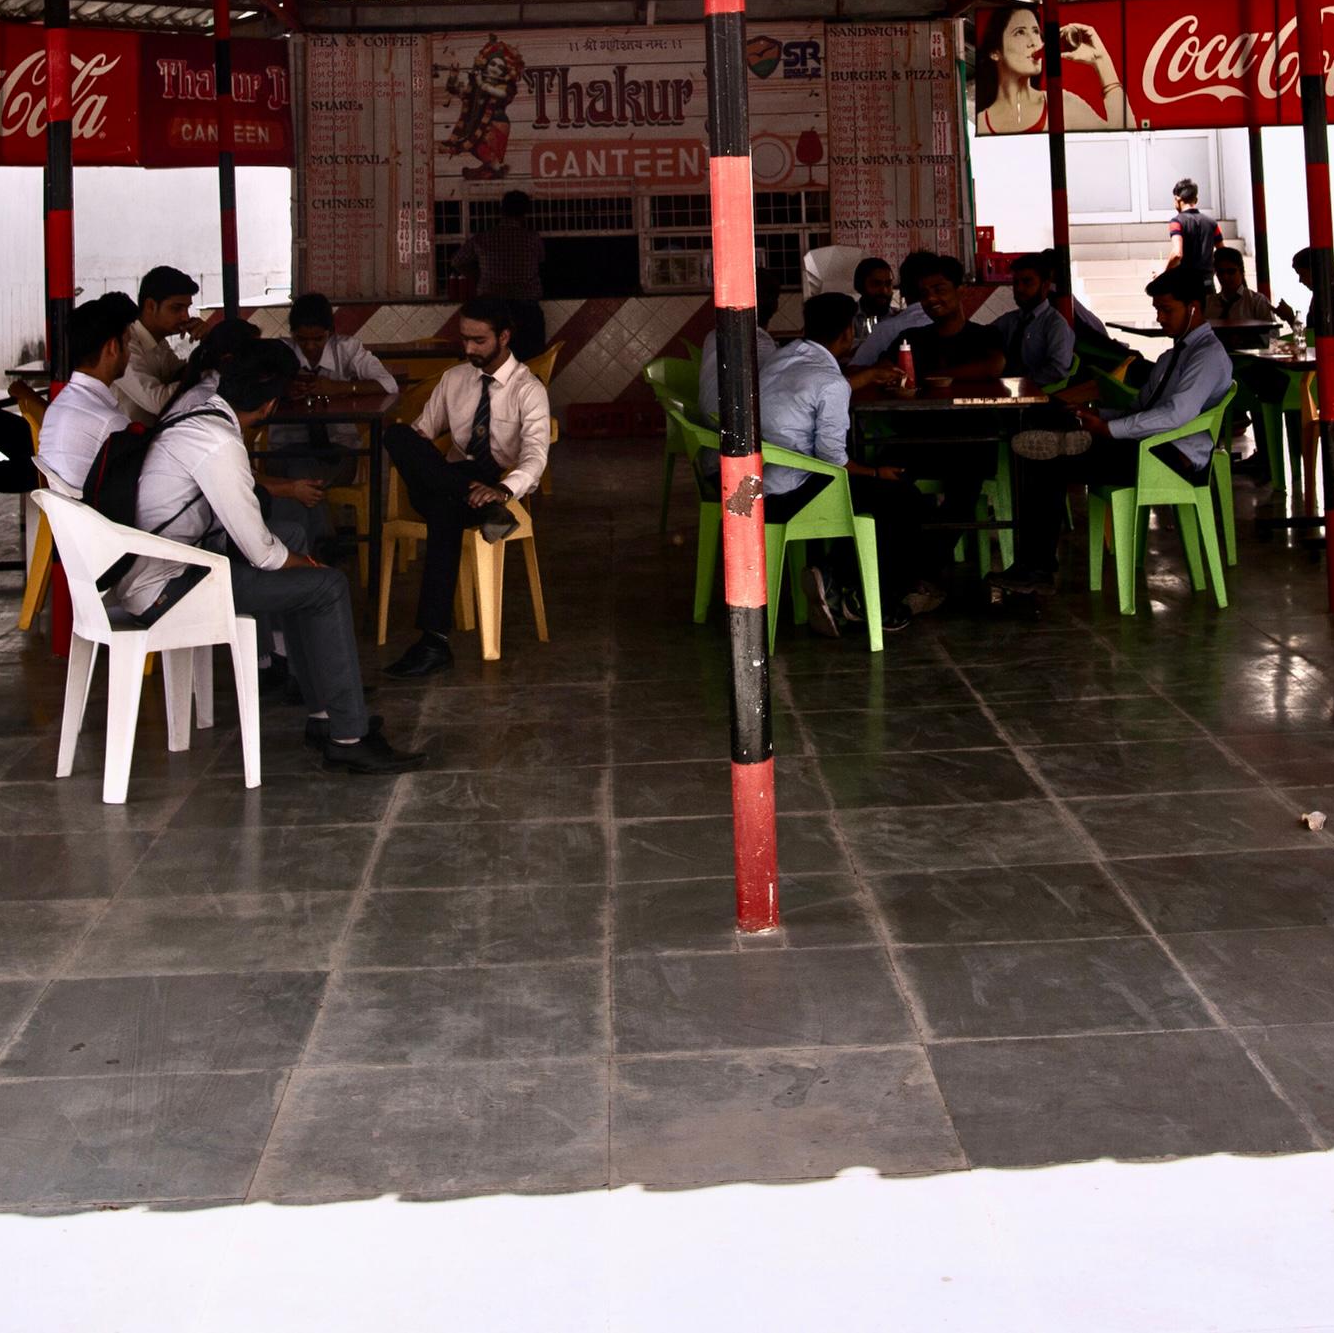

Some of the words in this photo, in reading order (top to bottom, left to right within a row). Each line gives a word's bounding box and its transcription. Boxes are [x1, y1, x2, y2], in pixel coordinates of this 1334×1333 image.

[311, 36, 339, 47] TEA
[363, 36, 419, 47] COFFEE
[156, 58, 262, 103] Thaur
[831, 70, 888, 81] BURGER
[891, 70, 902, 81] &
[523, 66, 694, 130] Thakur
[181, 123, 270, 143] CANEEN
[538, 148, 700, 179] CANTEEN
[312, 198, 376, 210] CHINESE
[835, 219, 873, 229] PASTA
[880, 219, 890, 229] &
